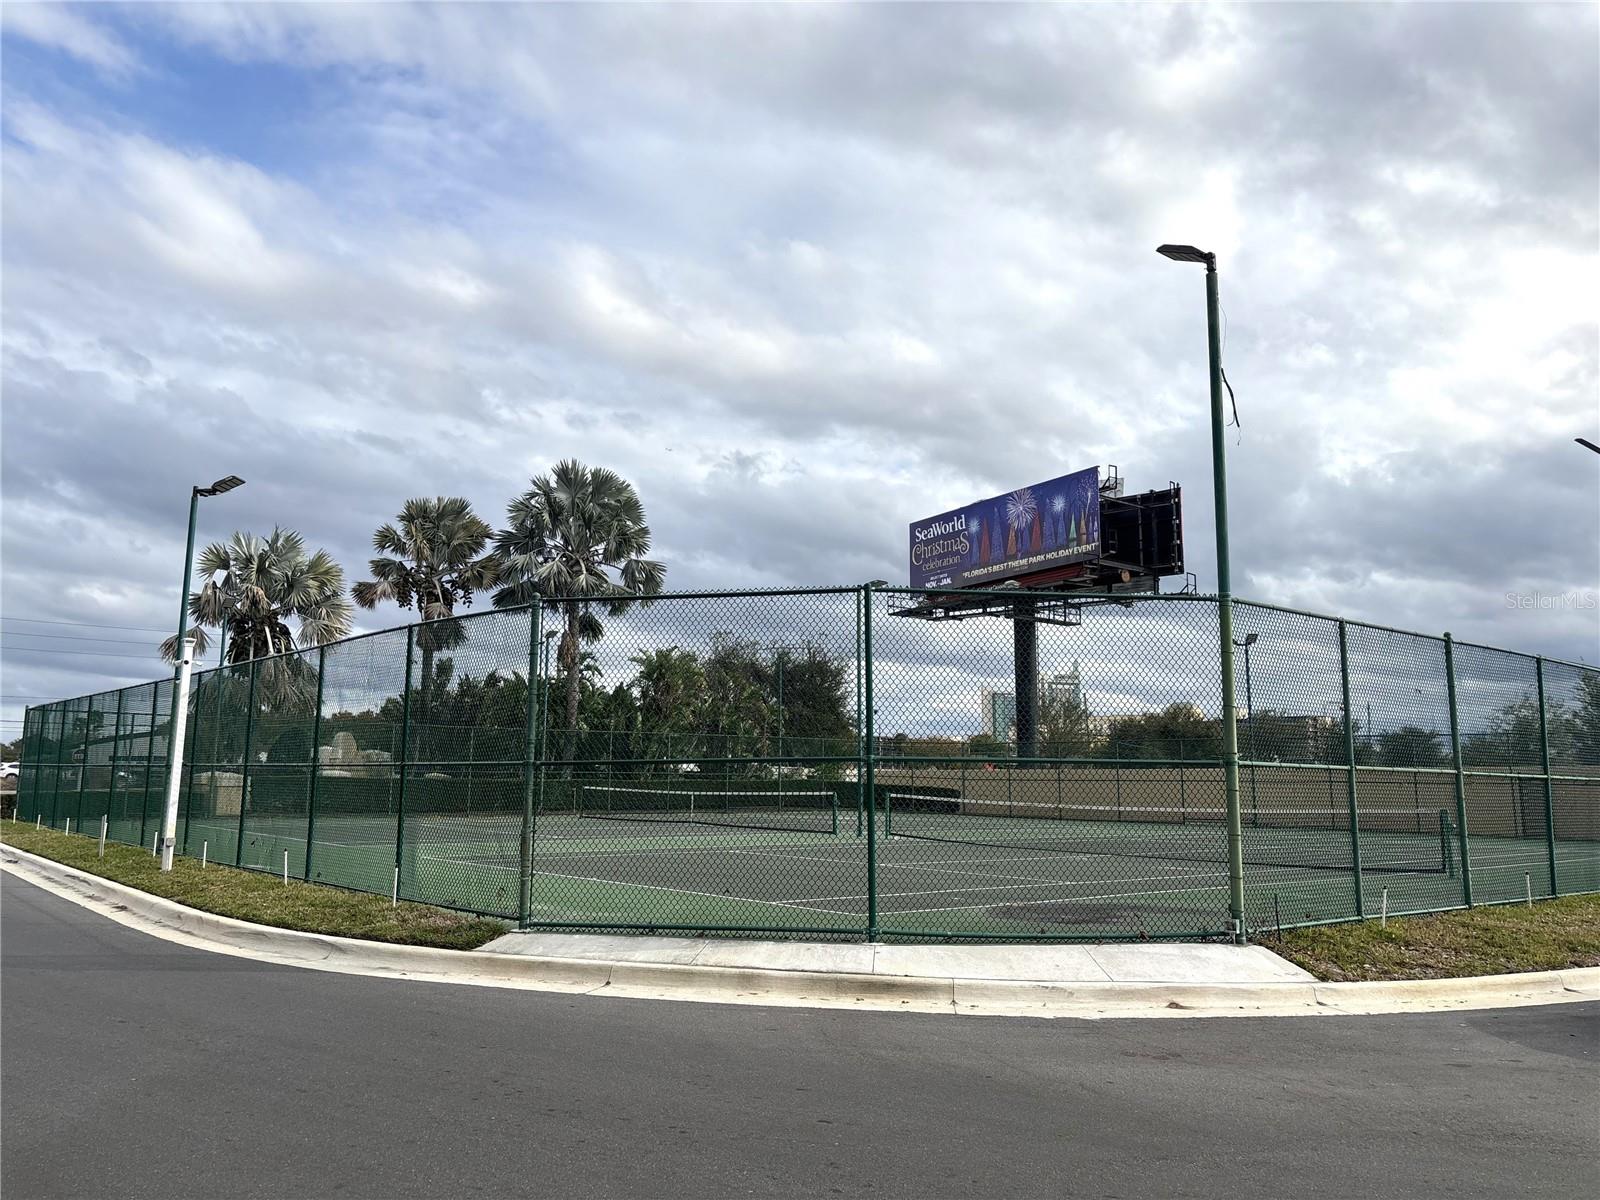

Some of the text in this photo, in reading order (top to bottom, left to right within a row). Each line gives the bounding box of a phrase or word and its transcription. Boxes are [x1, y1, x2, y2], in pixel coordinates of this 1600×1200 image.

[915, 514, 966, 542] SeaWorld
[992, 562, 1008, 573] BEST
[1008, 558, 1029, 569] THEME
[1028, 553, 1046, 565] PARK
[1045, 547, 1074, 561] HOLIDAY
